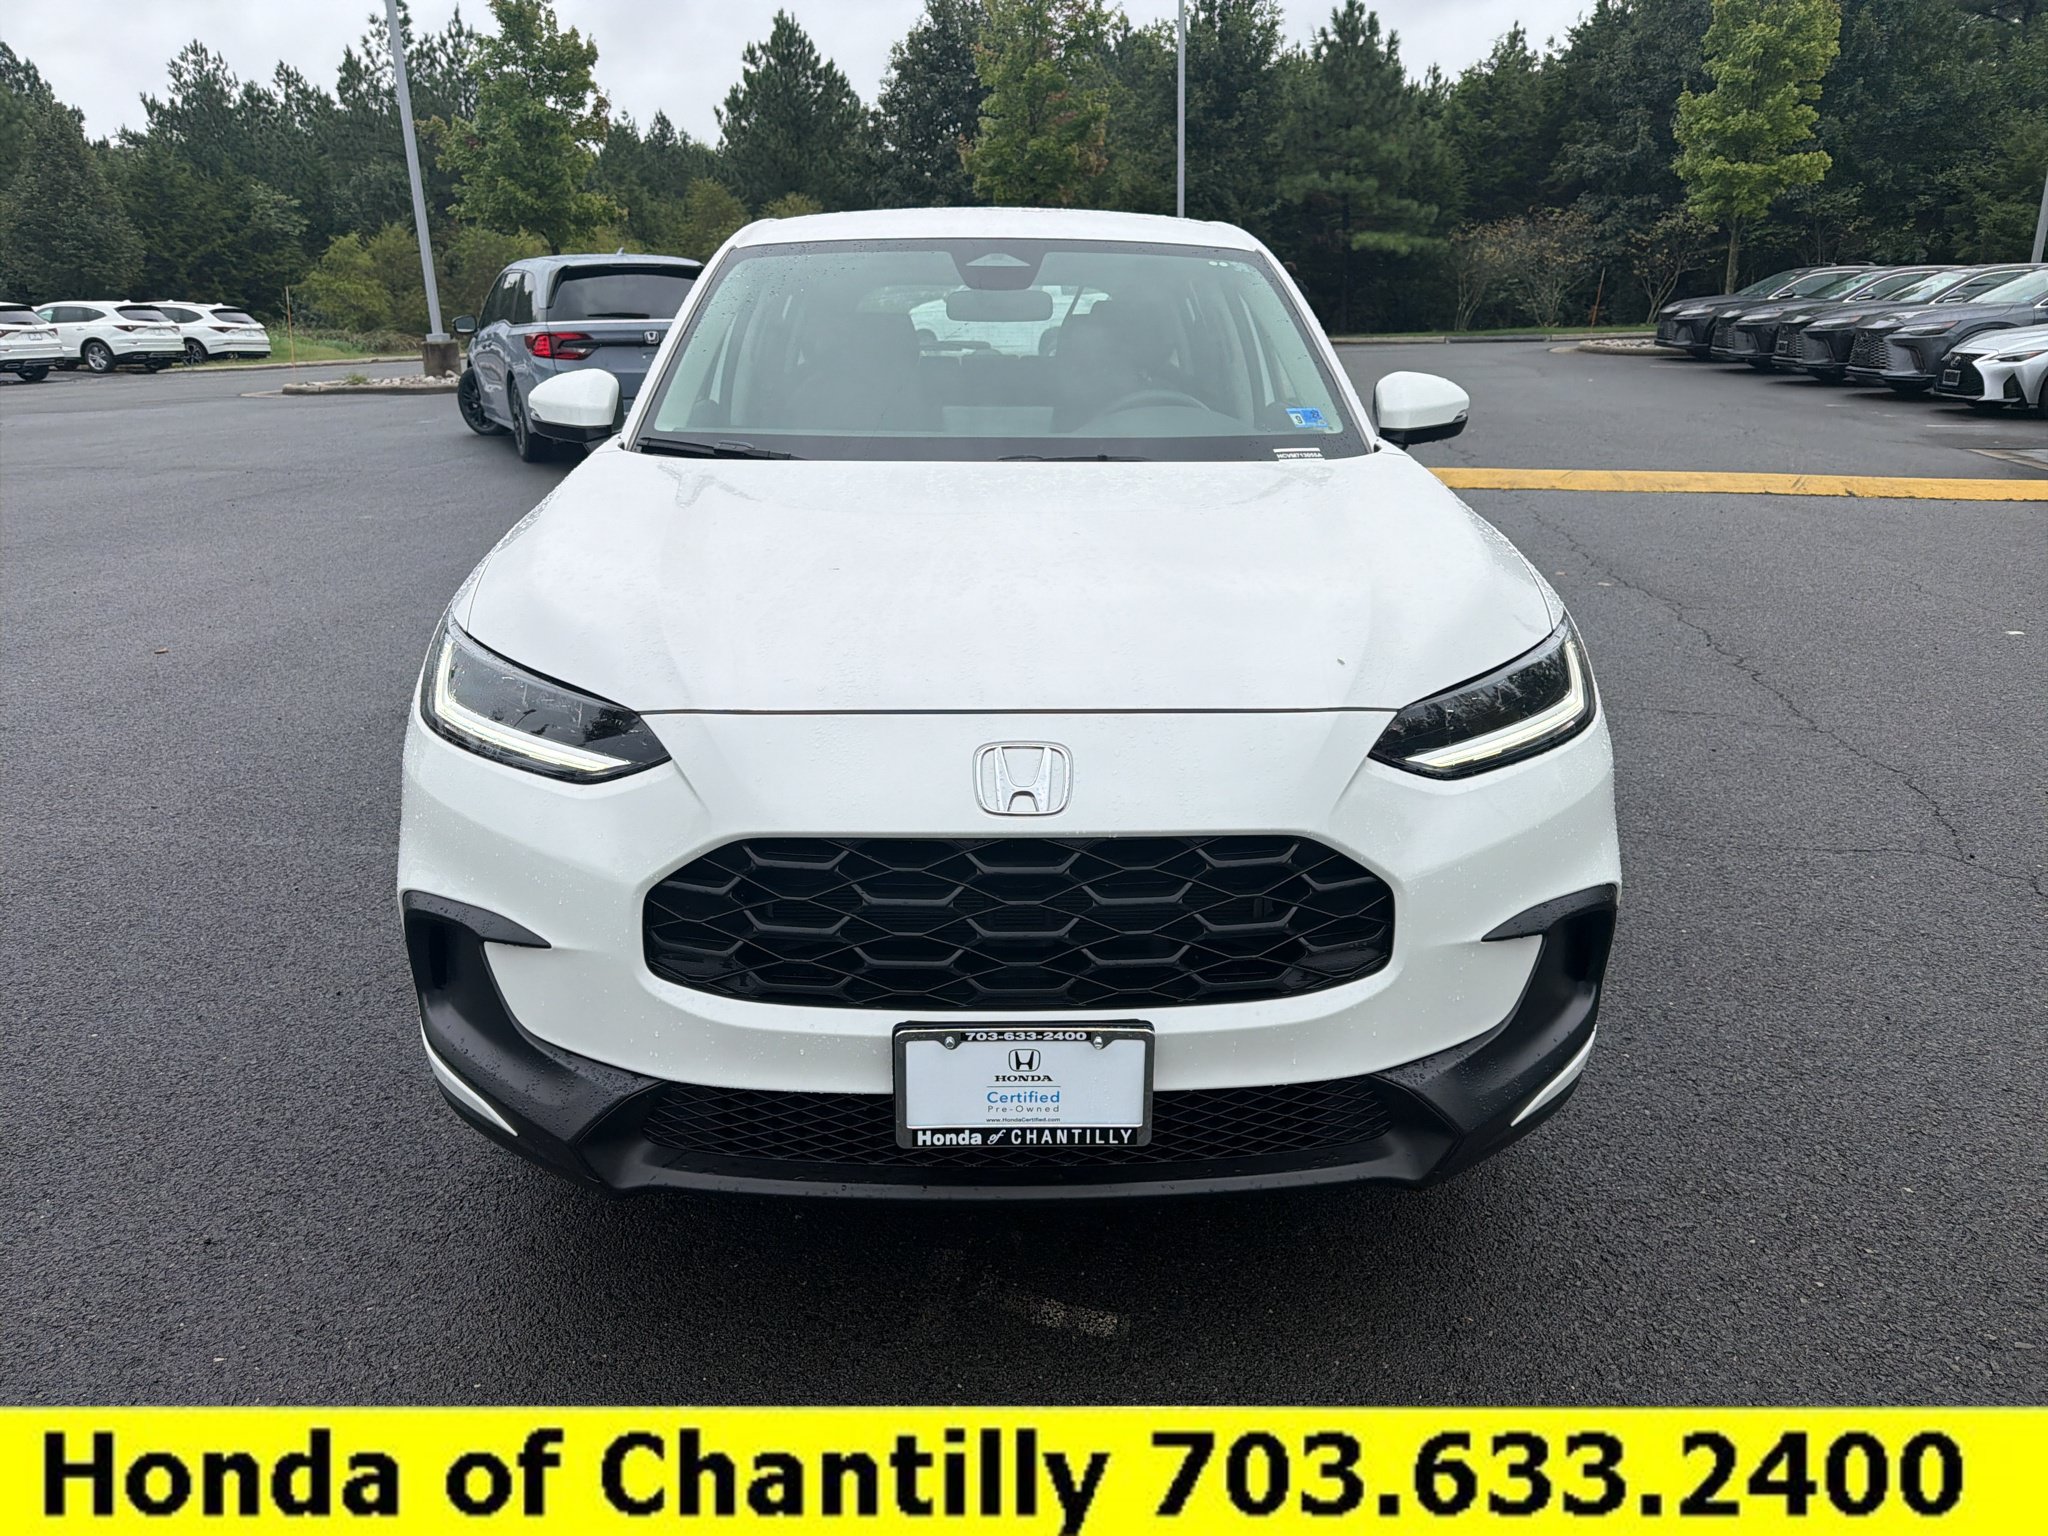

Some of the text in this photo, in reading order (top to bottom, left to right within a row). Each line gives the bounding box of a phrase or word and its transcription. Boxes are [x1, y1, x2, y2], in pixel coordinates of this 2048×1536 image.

[965, 1031, 1087, 1041] 703-633-2400
[994, 1074, 1053, 1082] HONDA
[986, 1090, 1060, 1104] Certified
[987, 1104, 1060, 1113] Pre-Owned
[917, 1129, 1133, 1146] Honda of CHANTILLY
